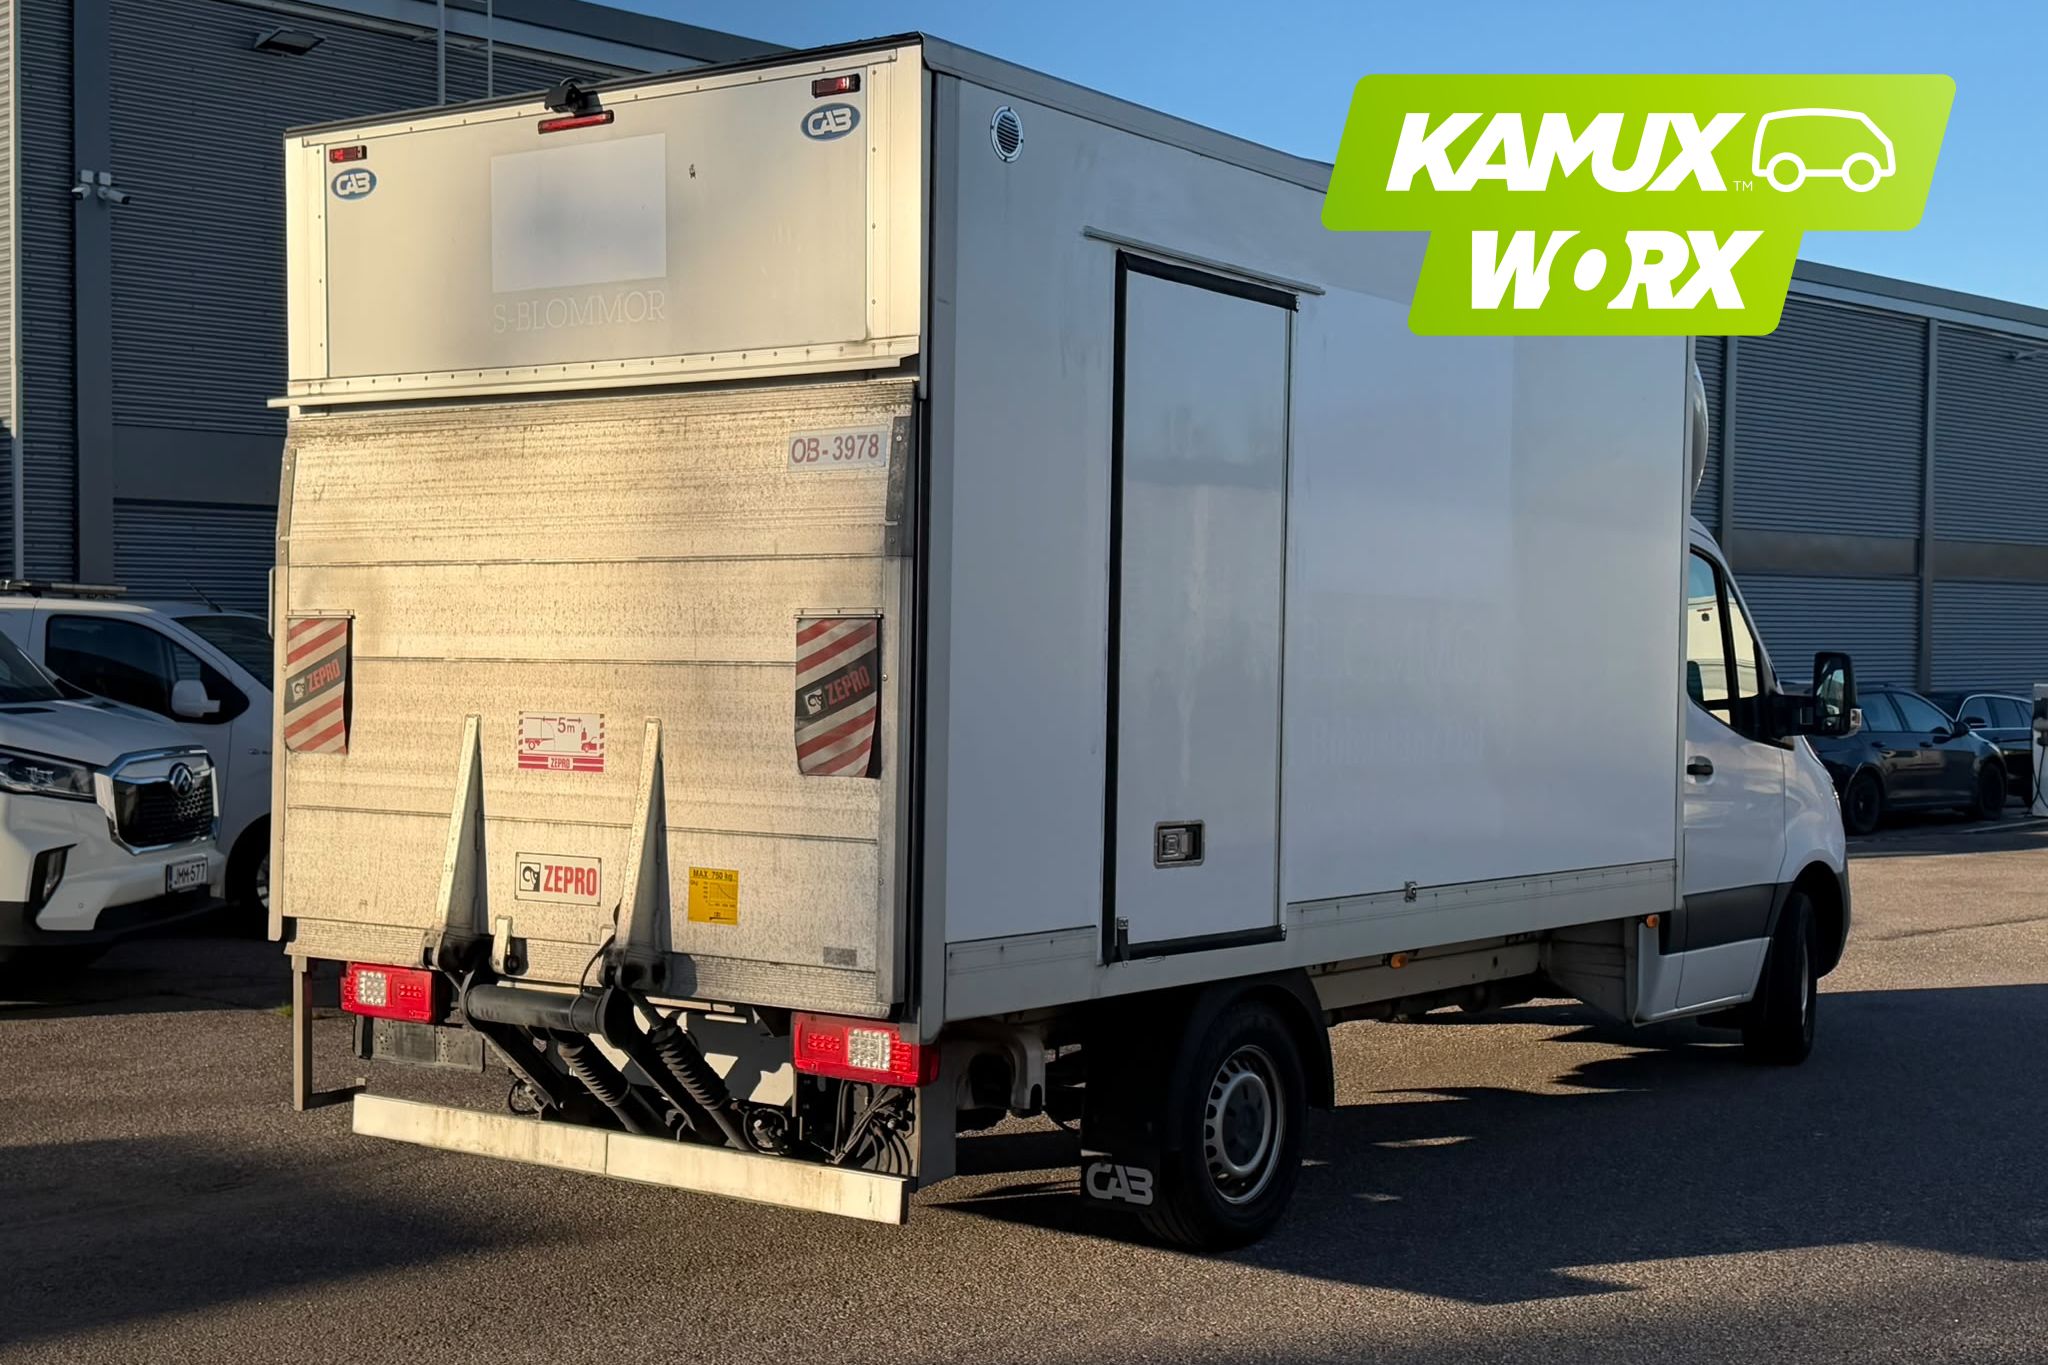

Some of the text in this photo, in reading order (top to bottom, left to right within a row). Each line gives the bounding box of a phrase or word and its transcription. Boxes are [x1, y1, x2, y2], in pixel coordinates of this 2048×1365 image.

[807, 107, 852, 136] CAB
[336, 172, 371, 196] CAB
[306, 659, 341, 692] ZEPRO
[824, 665, 870, 705] ZEPRO
[550, 757, 571, 769] ZEPRO
[543, 865, 597, 896] ZEPRO
[1086, 1162, 1153, 1206] CAB
